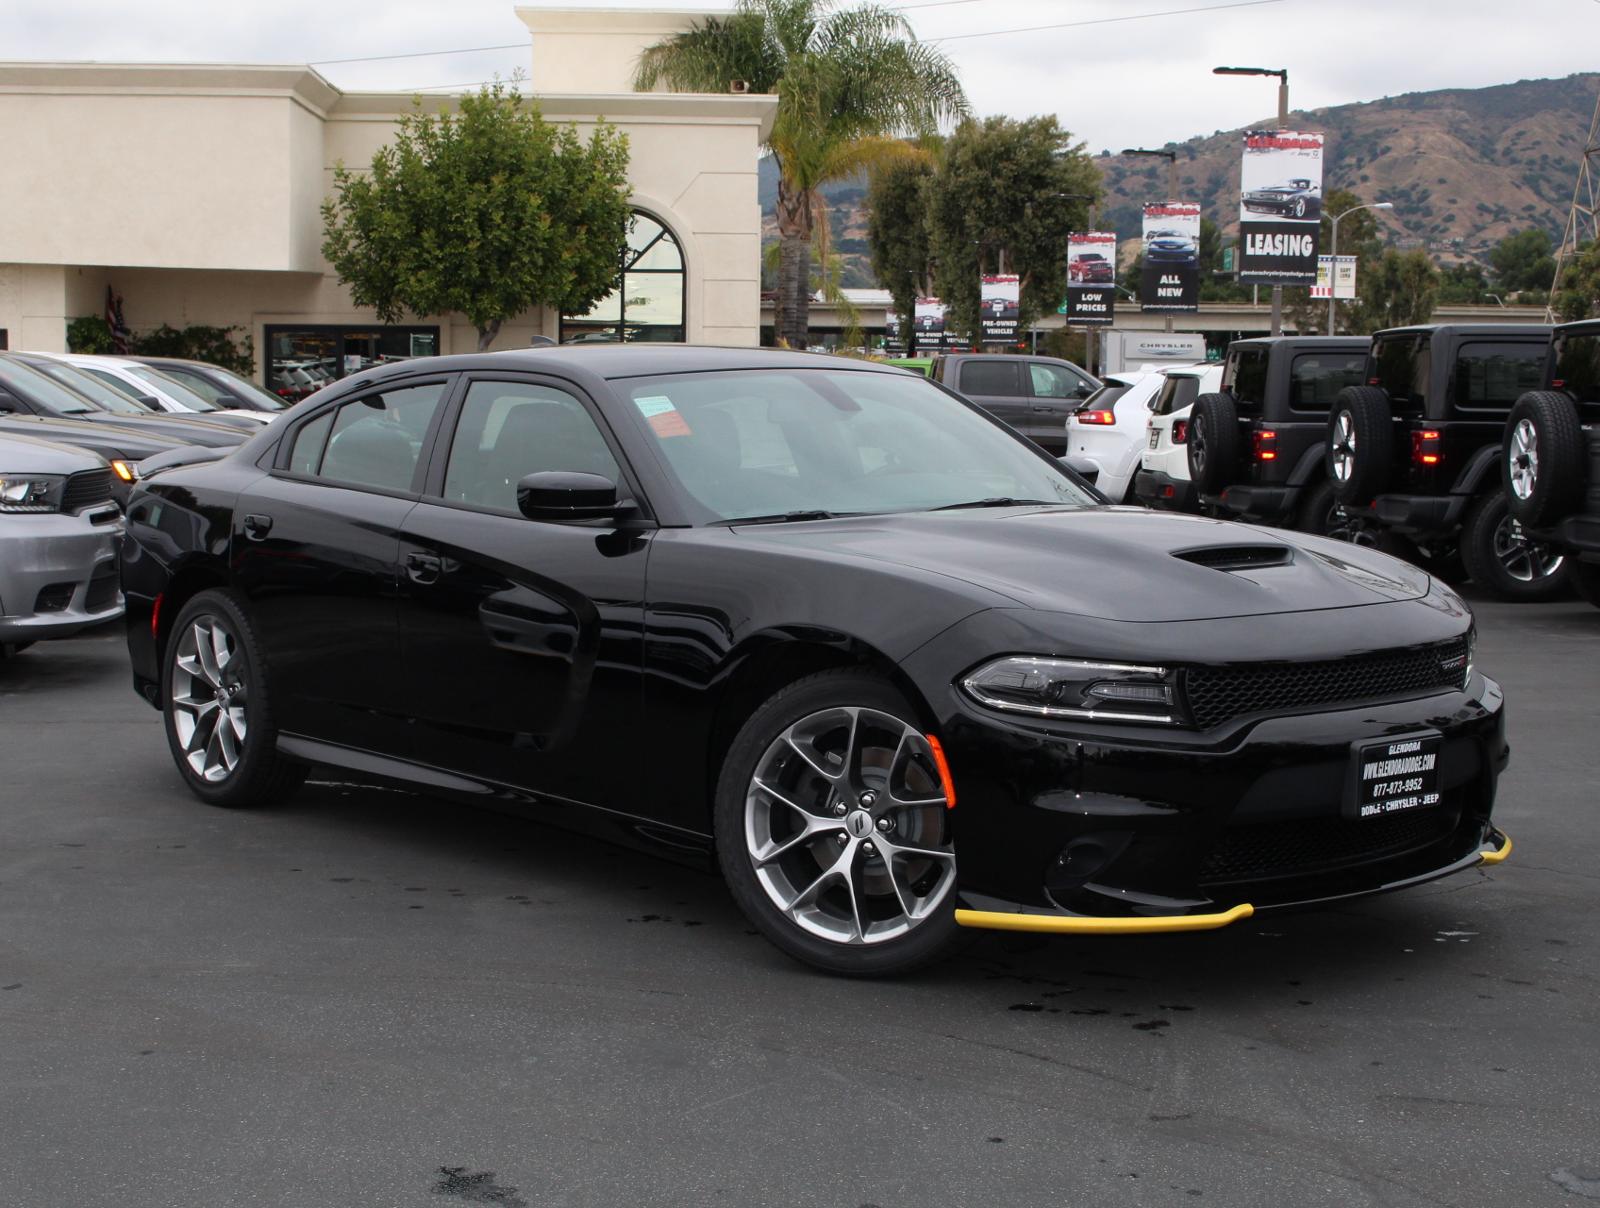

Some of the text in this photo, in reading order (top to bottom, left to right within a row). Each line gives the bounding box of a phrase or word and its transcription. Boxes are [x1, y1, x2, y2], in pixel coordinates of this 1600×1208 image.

[1246, 233, 1313, 257] LEASING
[1160, 274, 1181, 285] ALL
[1081, 293, 1102, 301] LOW
[1157, 287, 1183, 297] NEW
[1076, 303, 1107, 312] PRICES
[1388, 741, 1421, 755] GLENDORA
[1373, 778, 1423, 797] 877-873-9952
[1385, 797, 1418, 812] CHRYSLER
[1423, 793, 1440, 805] JEEP
